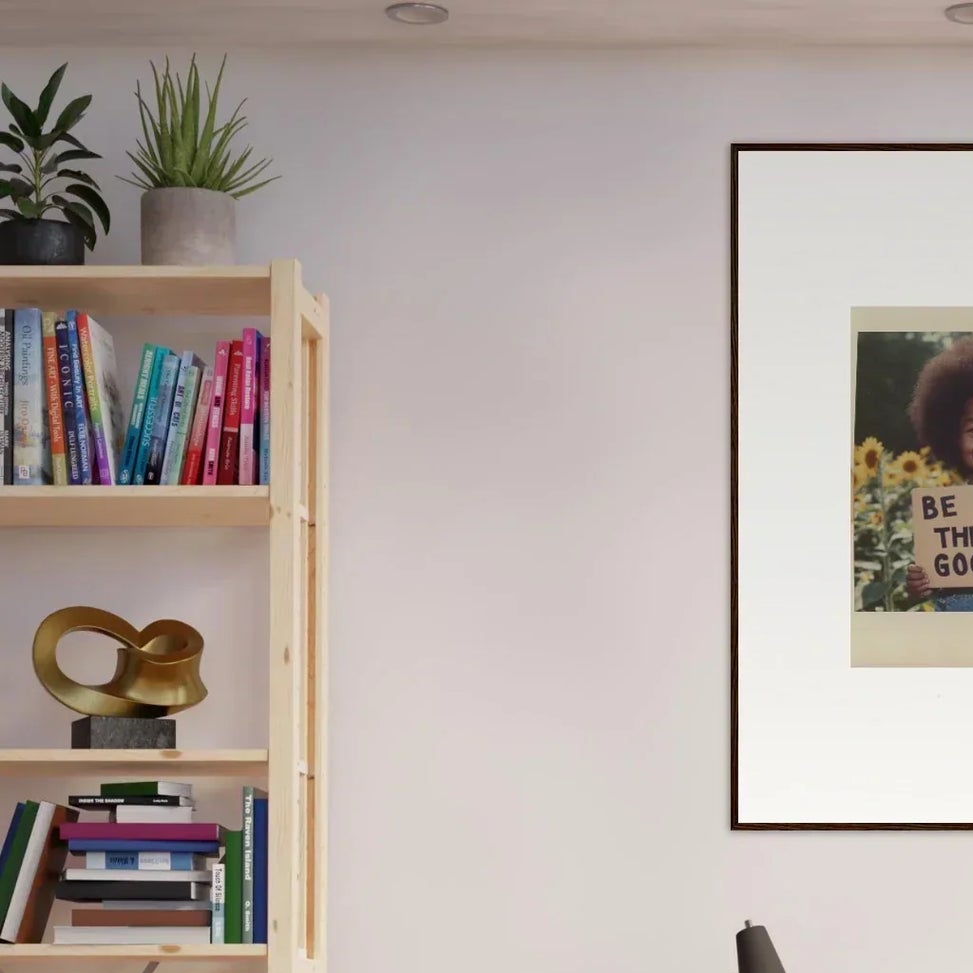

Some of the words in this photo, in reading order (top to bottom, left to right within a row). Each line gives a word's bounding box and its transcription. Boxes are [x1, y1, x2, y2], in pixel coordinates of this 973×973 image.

[22, 325, 32, 340] Oil
[71, 343, 80, 359] Find
[19, 342, 32, 386] Paintings
[48, 364, 58, 379] ART
[73, 359, 81, 385] Beauty
[80, 327, 93, 373] Watercolor
[87, 374, 98, 411] Portraits
[59, 344, 74, 408] ICONIC
[50, 385, 59, 402] With
[49, 402, 61, 425] Digital
[229, 397, 238, 416] Skills
[53, 425, 63, 442] Tools
[922, 495, 957, 520] BE
[244, 794, 252, 814] The
[244, 816, 252, 847] Raven
[244, 849, 252, 880] Island
[215, 868, 223, 883] Touch
